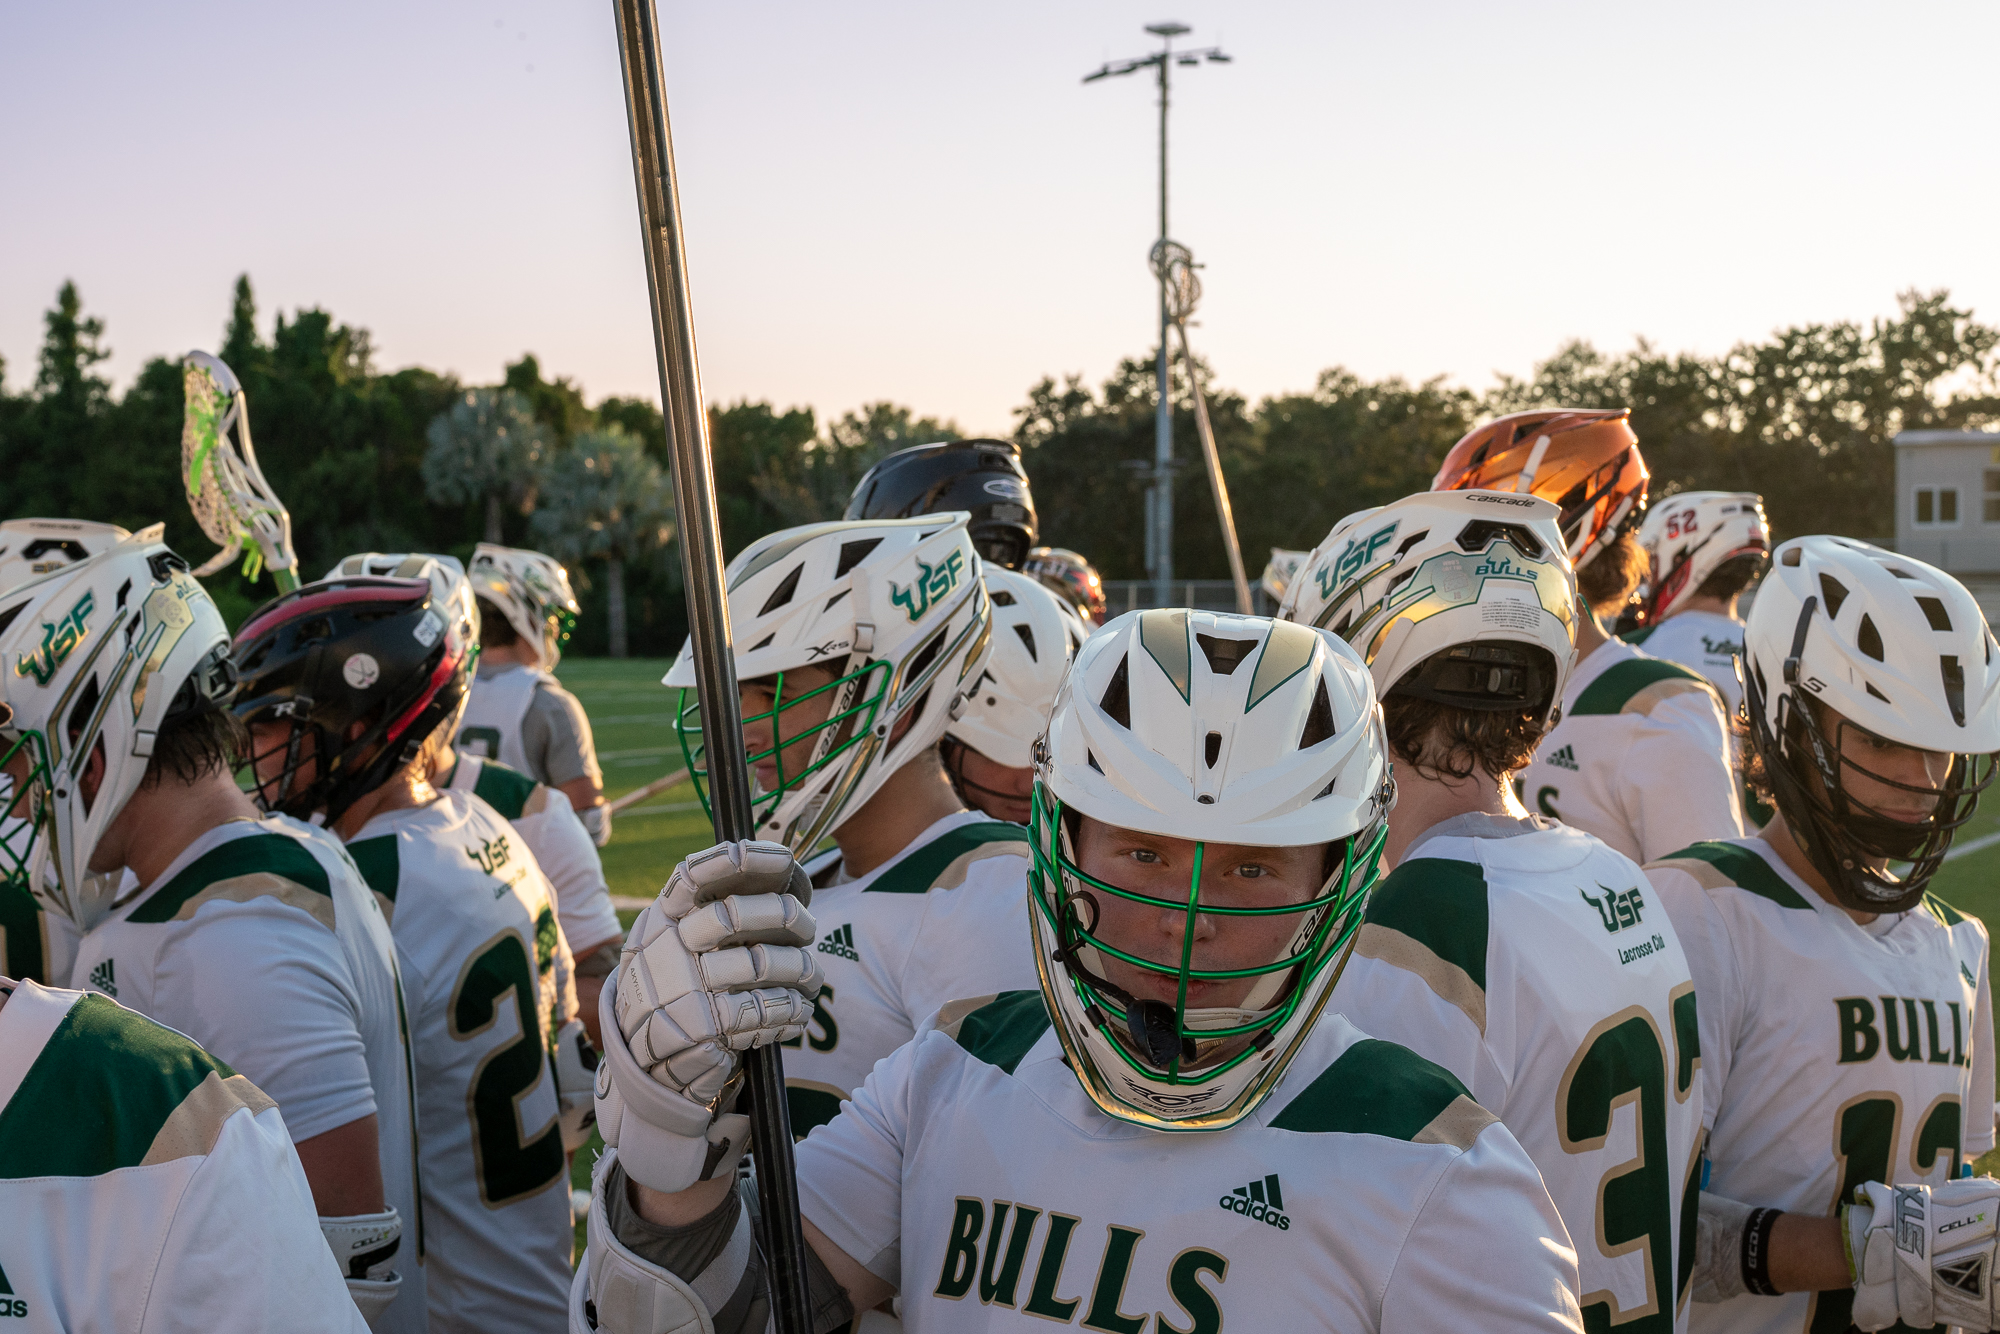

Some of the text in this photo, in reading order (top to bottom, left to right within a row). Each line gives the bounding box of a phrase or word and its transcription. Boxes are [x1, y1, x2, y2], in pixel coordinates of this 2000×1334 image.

[1466, 493, 1535, 509] cascade
[1667, 509, 1698, 540] 52
[1315, 518, 1403, 601] USF
[1475, 556, 1538, 580] BULLS
[888, 545, 965, 626] USF
[15, 588, 97, 688] USF
[1574, 879, 1646, 936] USF
[817, 940, 860, 963] adidas
[1617, 941, 1654, 966] Lacrosse
[630, 967, 645, 1004] AXYFLEX
[1832, 995, 1974, 1071] BULL
[448, 903, 565, 1211] 2
[1219, 1195, 1291, 1231] adidas
[932, 1195, 1230, 1334] BULLS
